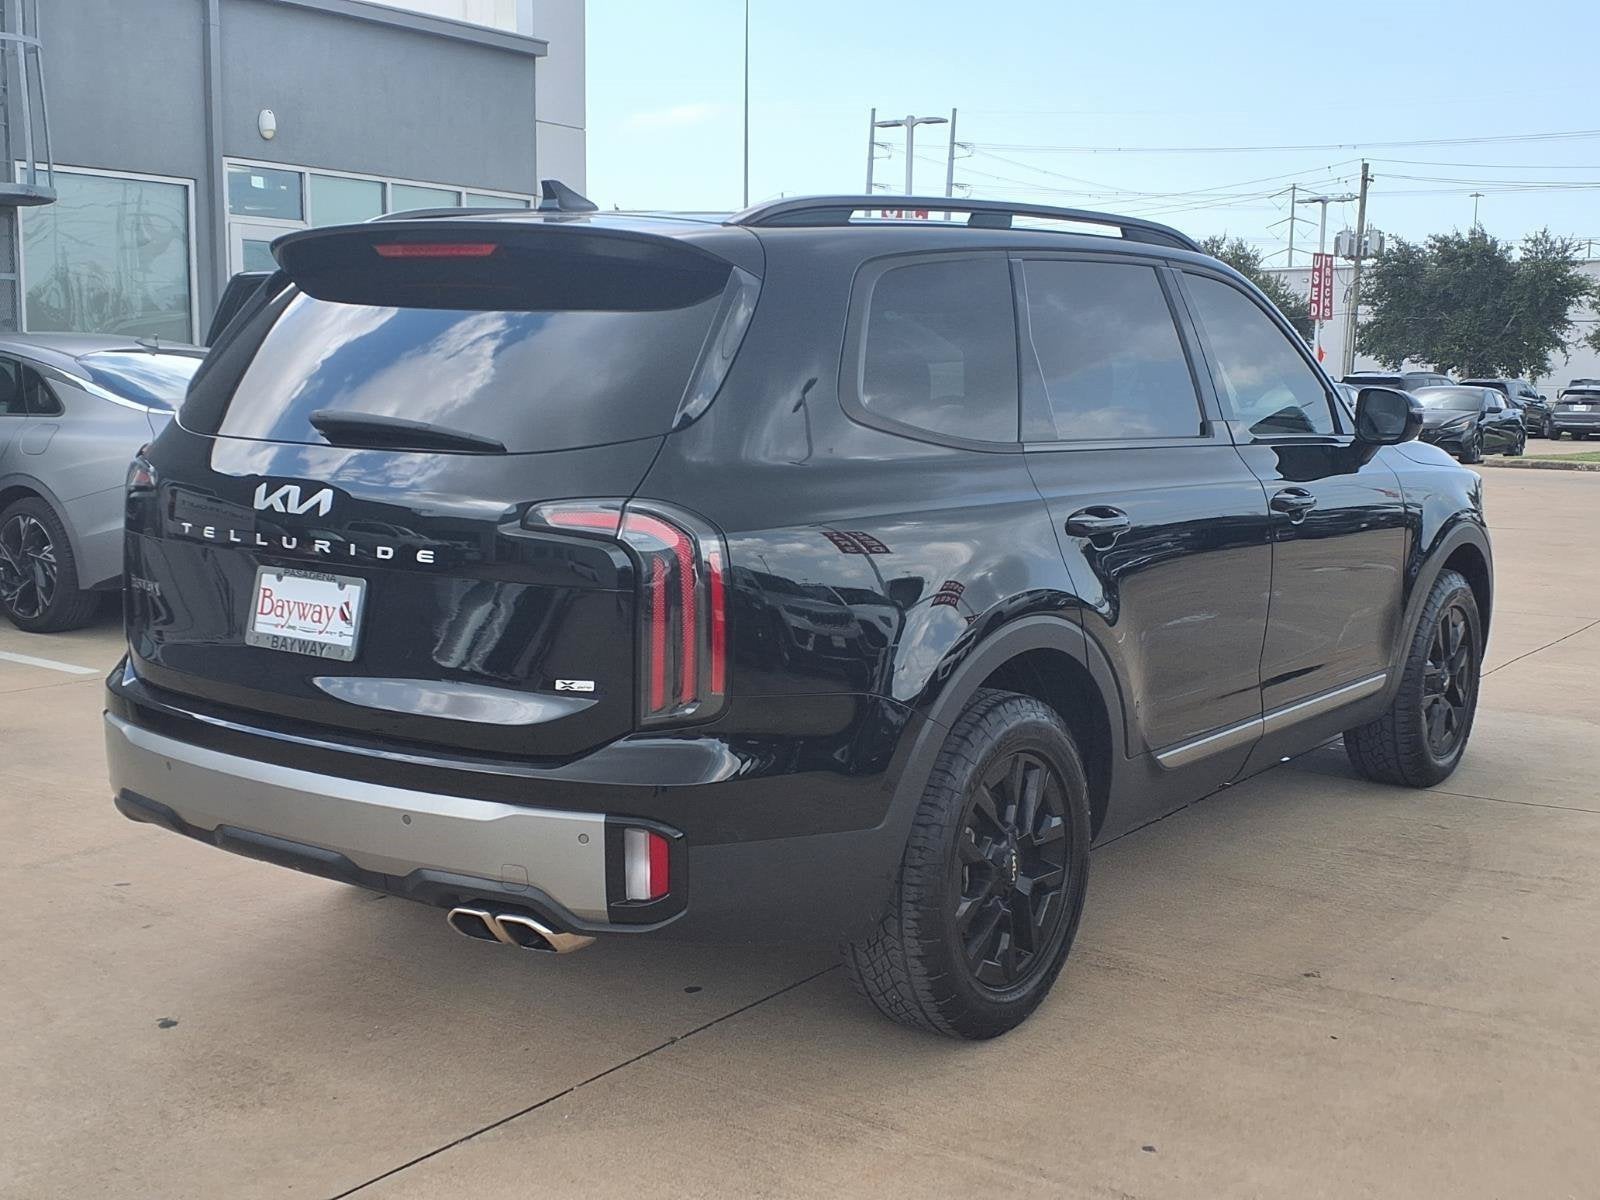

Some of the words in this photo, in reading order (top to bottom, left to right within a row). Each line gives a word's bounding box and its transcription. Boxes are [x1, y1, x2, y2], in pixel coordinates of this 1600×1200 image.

[1311, 255, 1321, 316] USED
[253, 482, 334, 517] KIA
[181, 522, 435, 564] TELLURIDE
[284, 568, 337, 582] PASADENA
[257, 587, 337, 635] Bayway
[271, 636, 327, 657] BAYWAY
